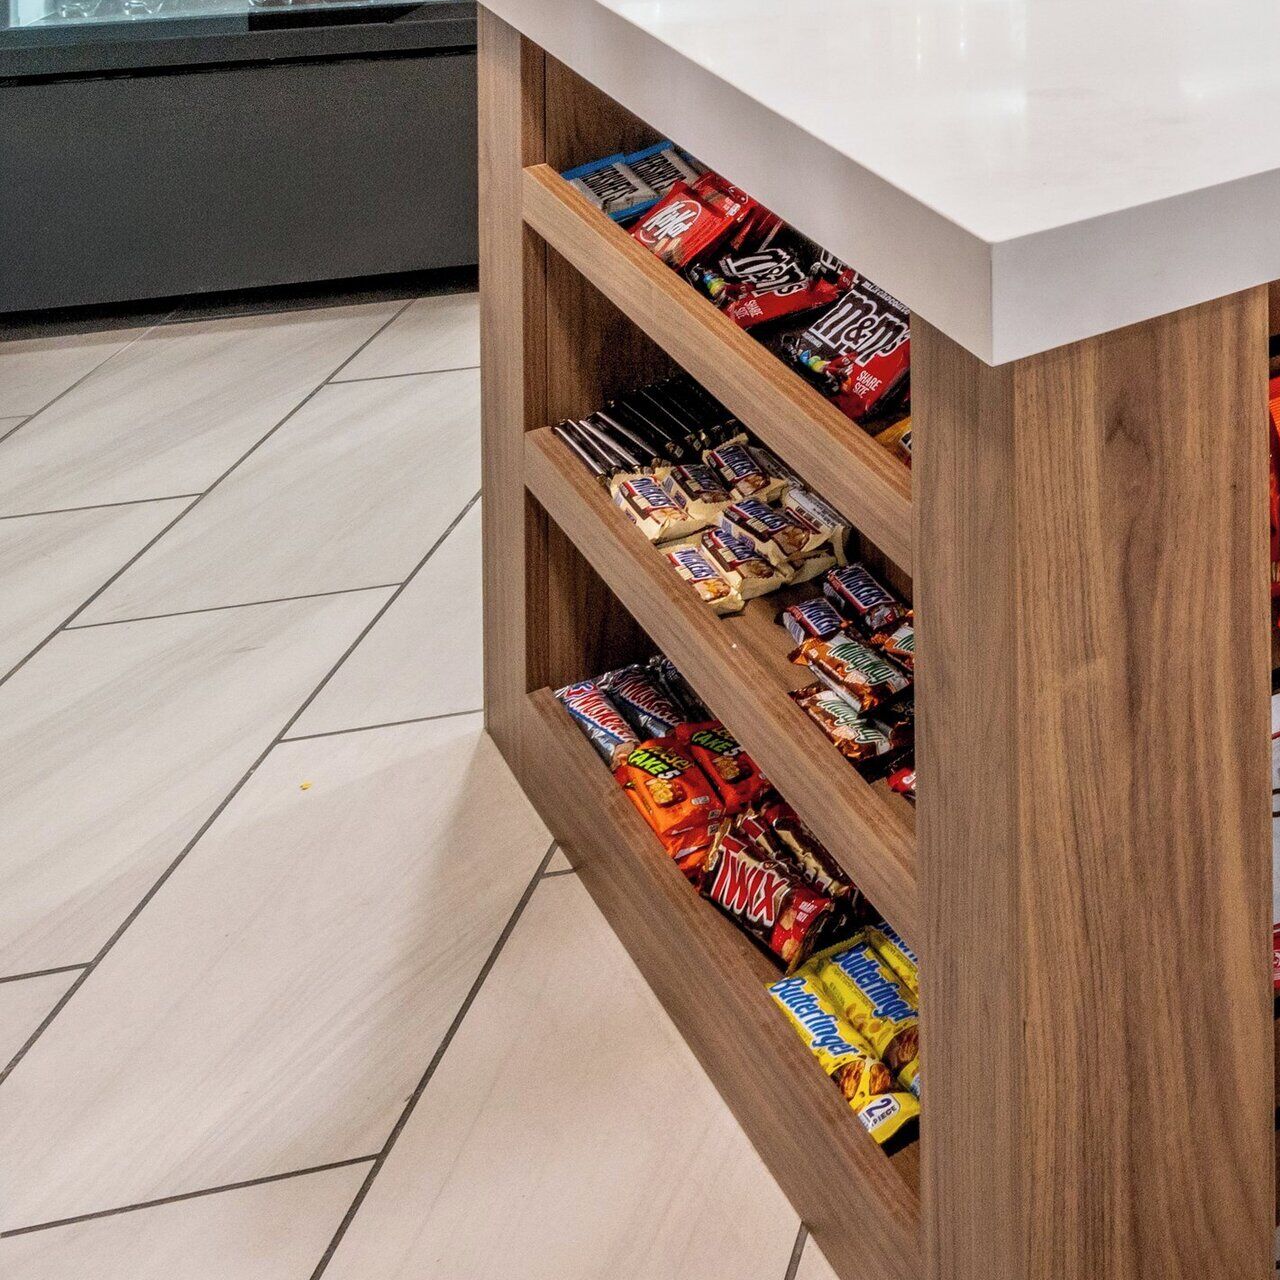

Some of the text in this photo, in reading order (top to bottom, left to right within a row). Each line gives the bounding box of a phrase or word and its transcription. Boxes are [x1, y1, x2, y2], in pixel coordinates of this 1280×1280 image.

[853, 383, 870, 399] SIZE
[857, 370, 882, 392] SHARE
[693, 730, 731, 752] TAKE
[629, 749, 681, 779] TAKE 5
[712, 836, 787, 926] TWIX
[769, 977, 859, 1056] Butterfinger
[867, 1098, 891, 1117] 2
[873, 1105, 897, 1127] PIECE
